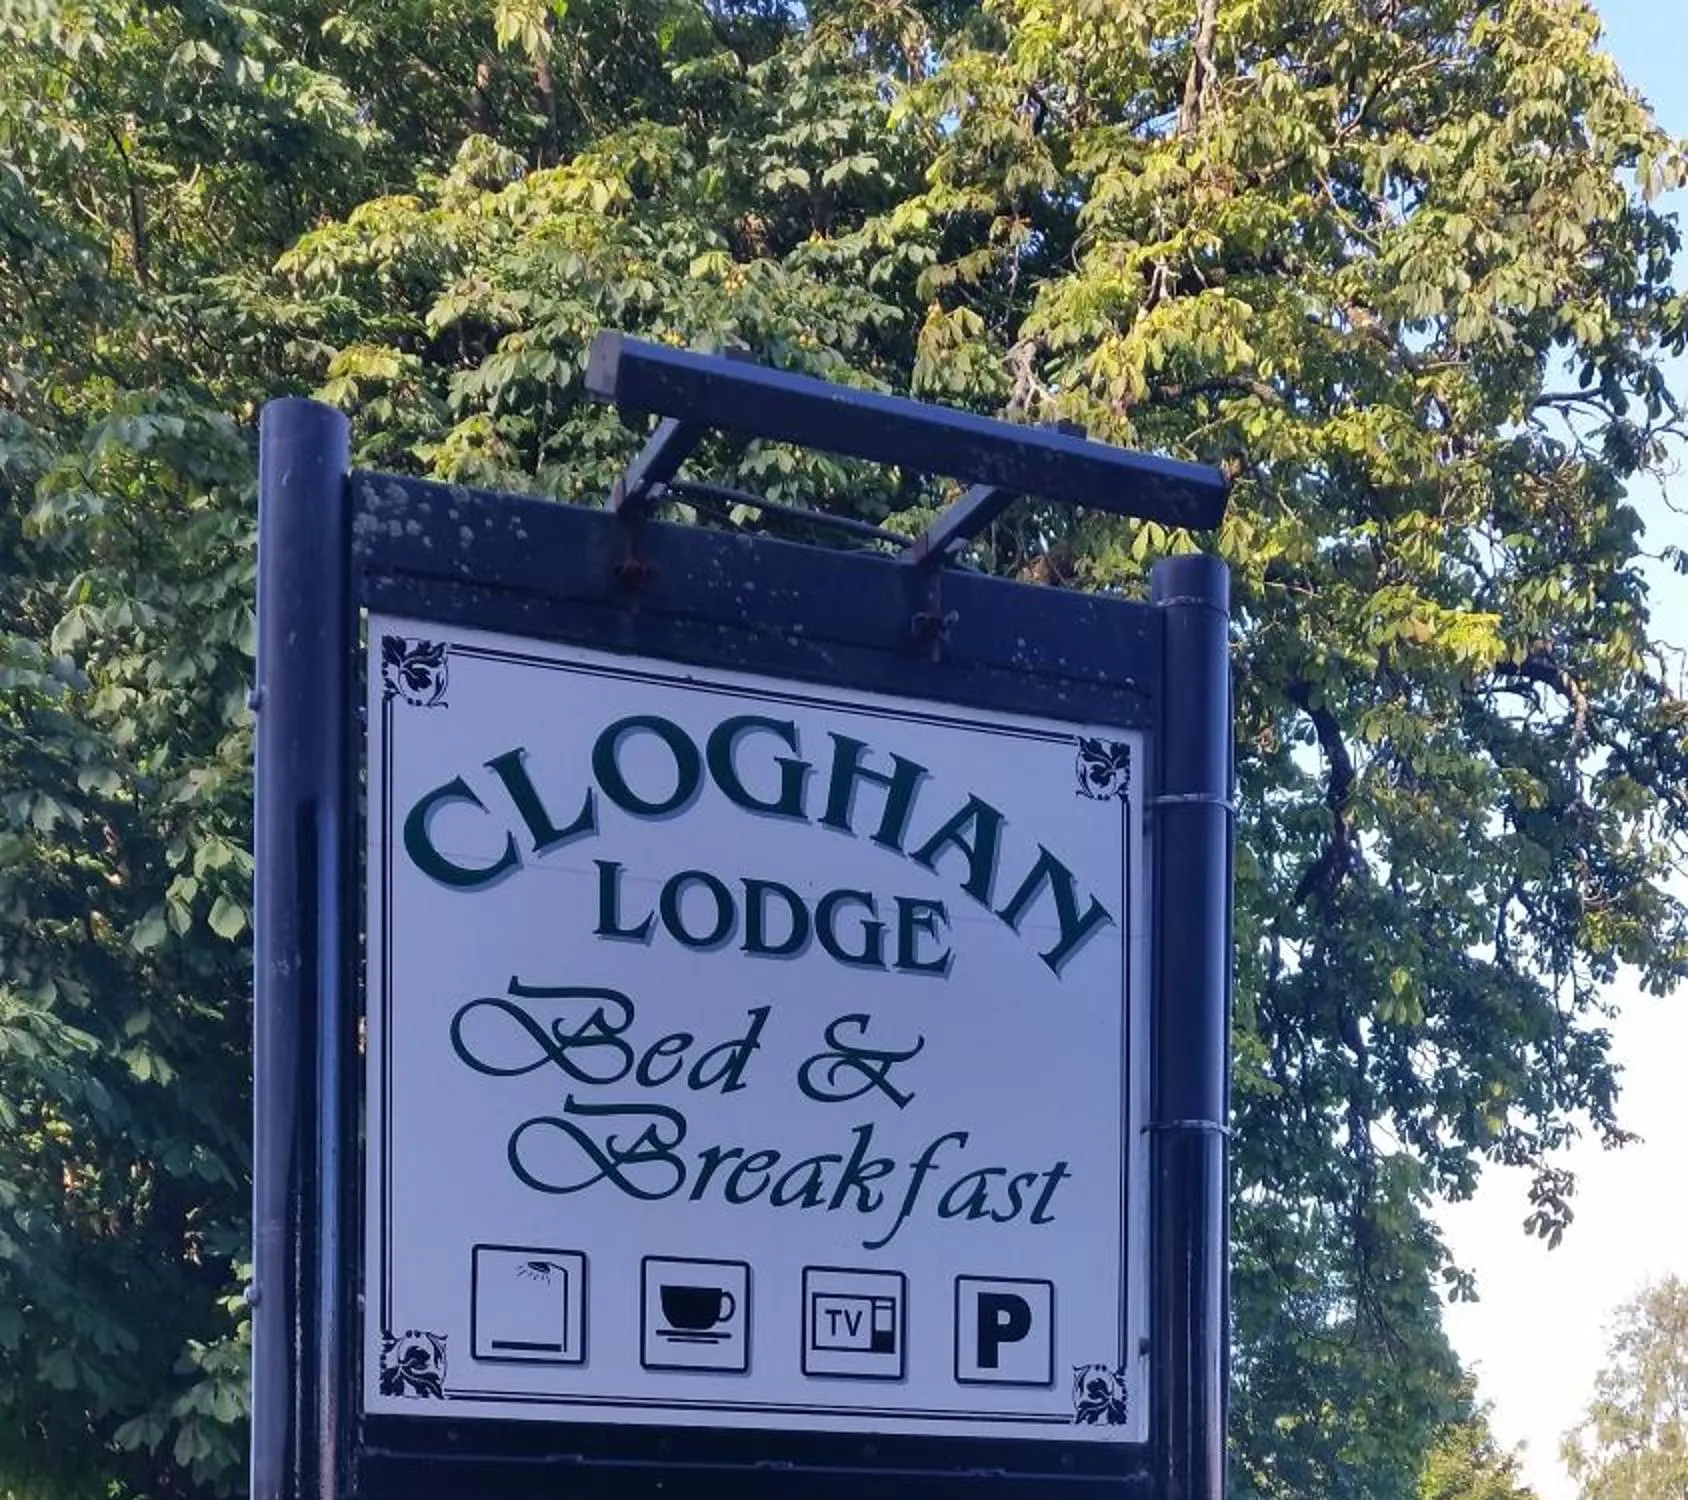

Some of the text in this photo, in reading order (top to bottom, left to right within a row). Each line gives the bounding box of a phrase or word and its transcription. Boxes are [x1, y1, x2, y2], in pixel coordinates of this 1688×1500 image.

[403, 715, 1116, 981] CLOGHAN
[592, 859, 956, 980] LODGE
[450, 975, 925, 1110] Bed &
[508, 1093, 1072, 1250] Breakfast
[824, 1308, 863, 1338] TV
[976, 1291, 1033, 1369] P
